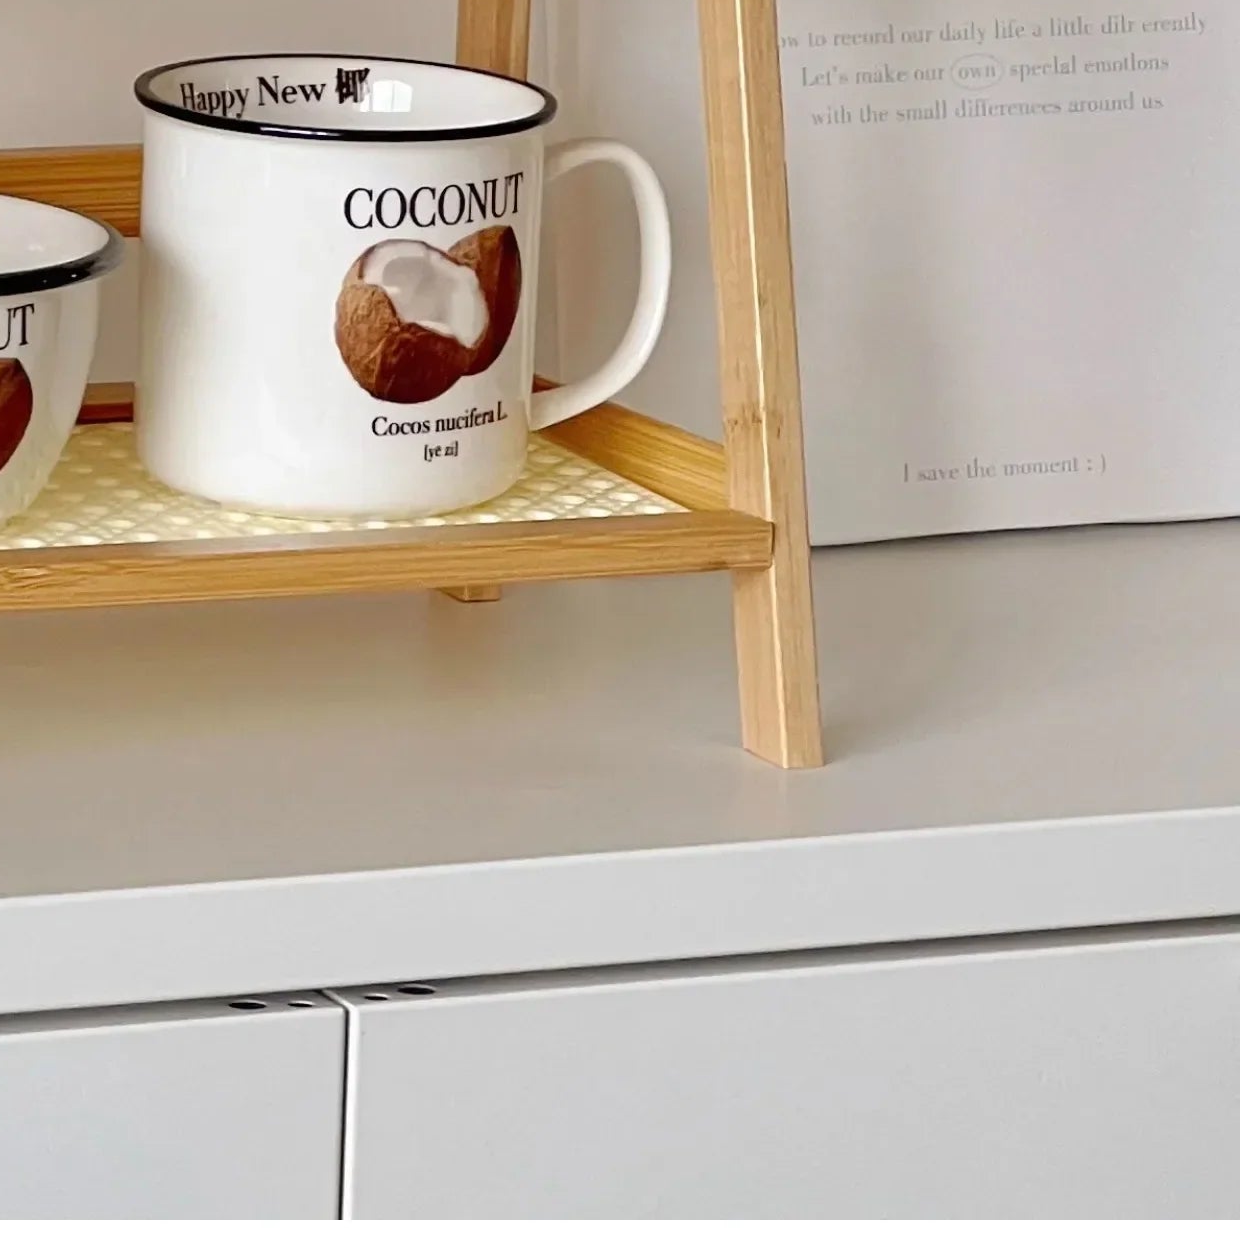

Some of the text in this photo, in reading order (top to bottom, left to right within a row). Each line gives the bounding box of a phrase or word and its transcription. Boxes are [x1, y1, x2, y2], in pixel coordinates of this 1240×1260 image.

[808, 32, 827, 48] to
[833, 24, 895, 46] record
[939, 21, 986, 45] daily
[994, 17, 1026, 39] life
[1031, 24, 1043, 38] a
[855, 63, 908, 85] make
[913, 68, 946, 82] our
[958, 65, 997, 80] own
[179, 81, 250, 119] Happy
[256, 75, 327, 106] New
[811, 105, 852, 126] with
[859, 102, 889, 123] the
[895, 98, 948, 120] small
[1067, 90, 1135, 114] around
[1141, 95, 1165, 110] us
[343, 172, 525, 230] COCONUT
[371, 415, 431, 437] Cocos
[434, 407, 495, 433] nucifera
[916, 466, 959, 482] save
[966, 457, 996, 479] the
[1003, 456, 1079, 476] moment
